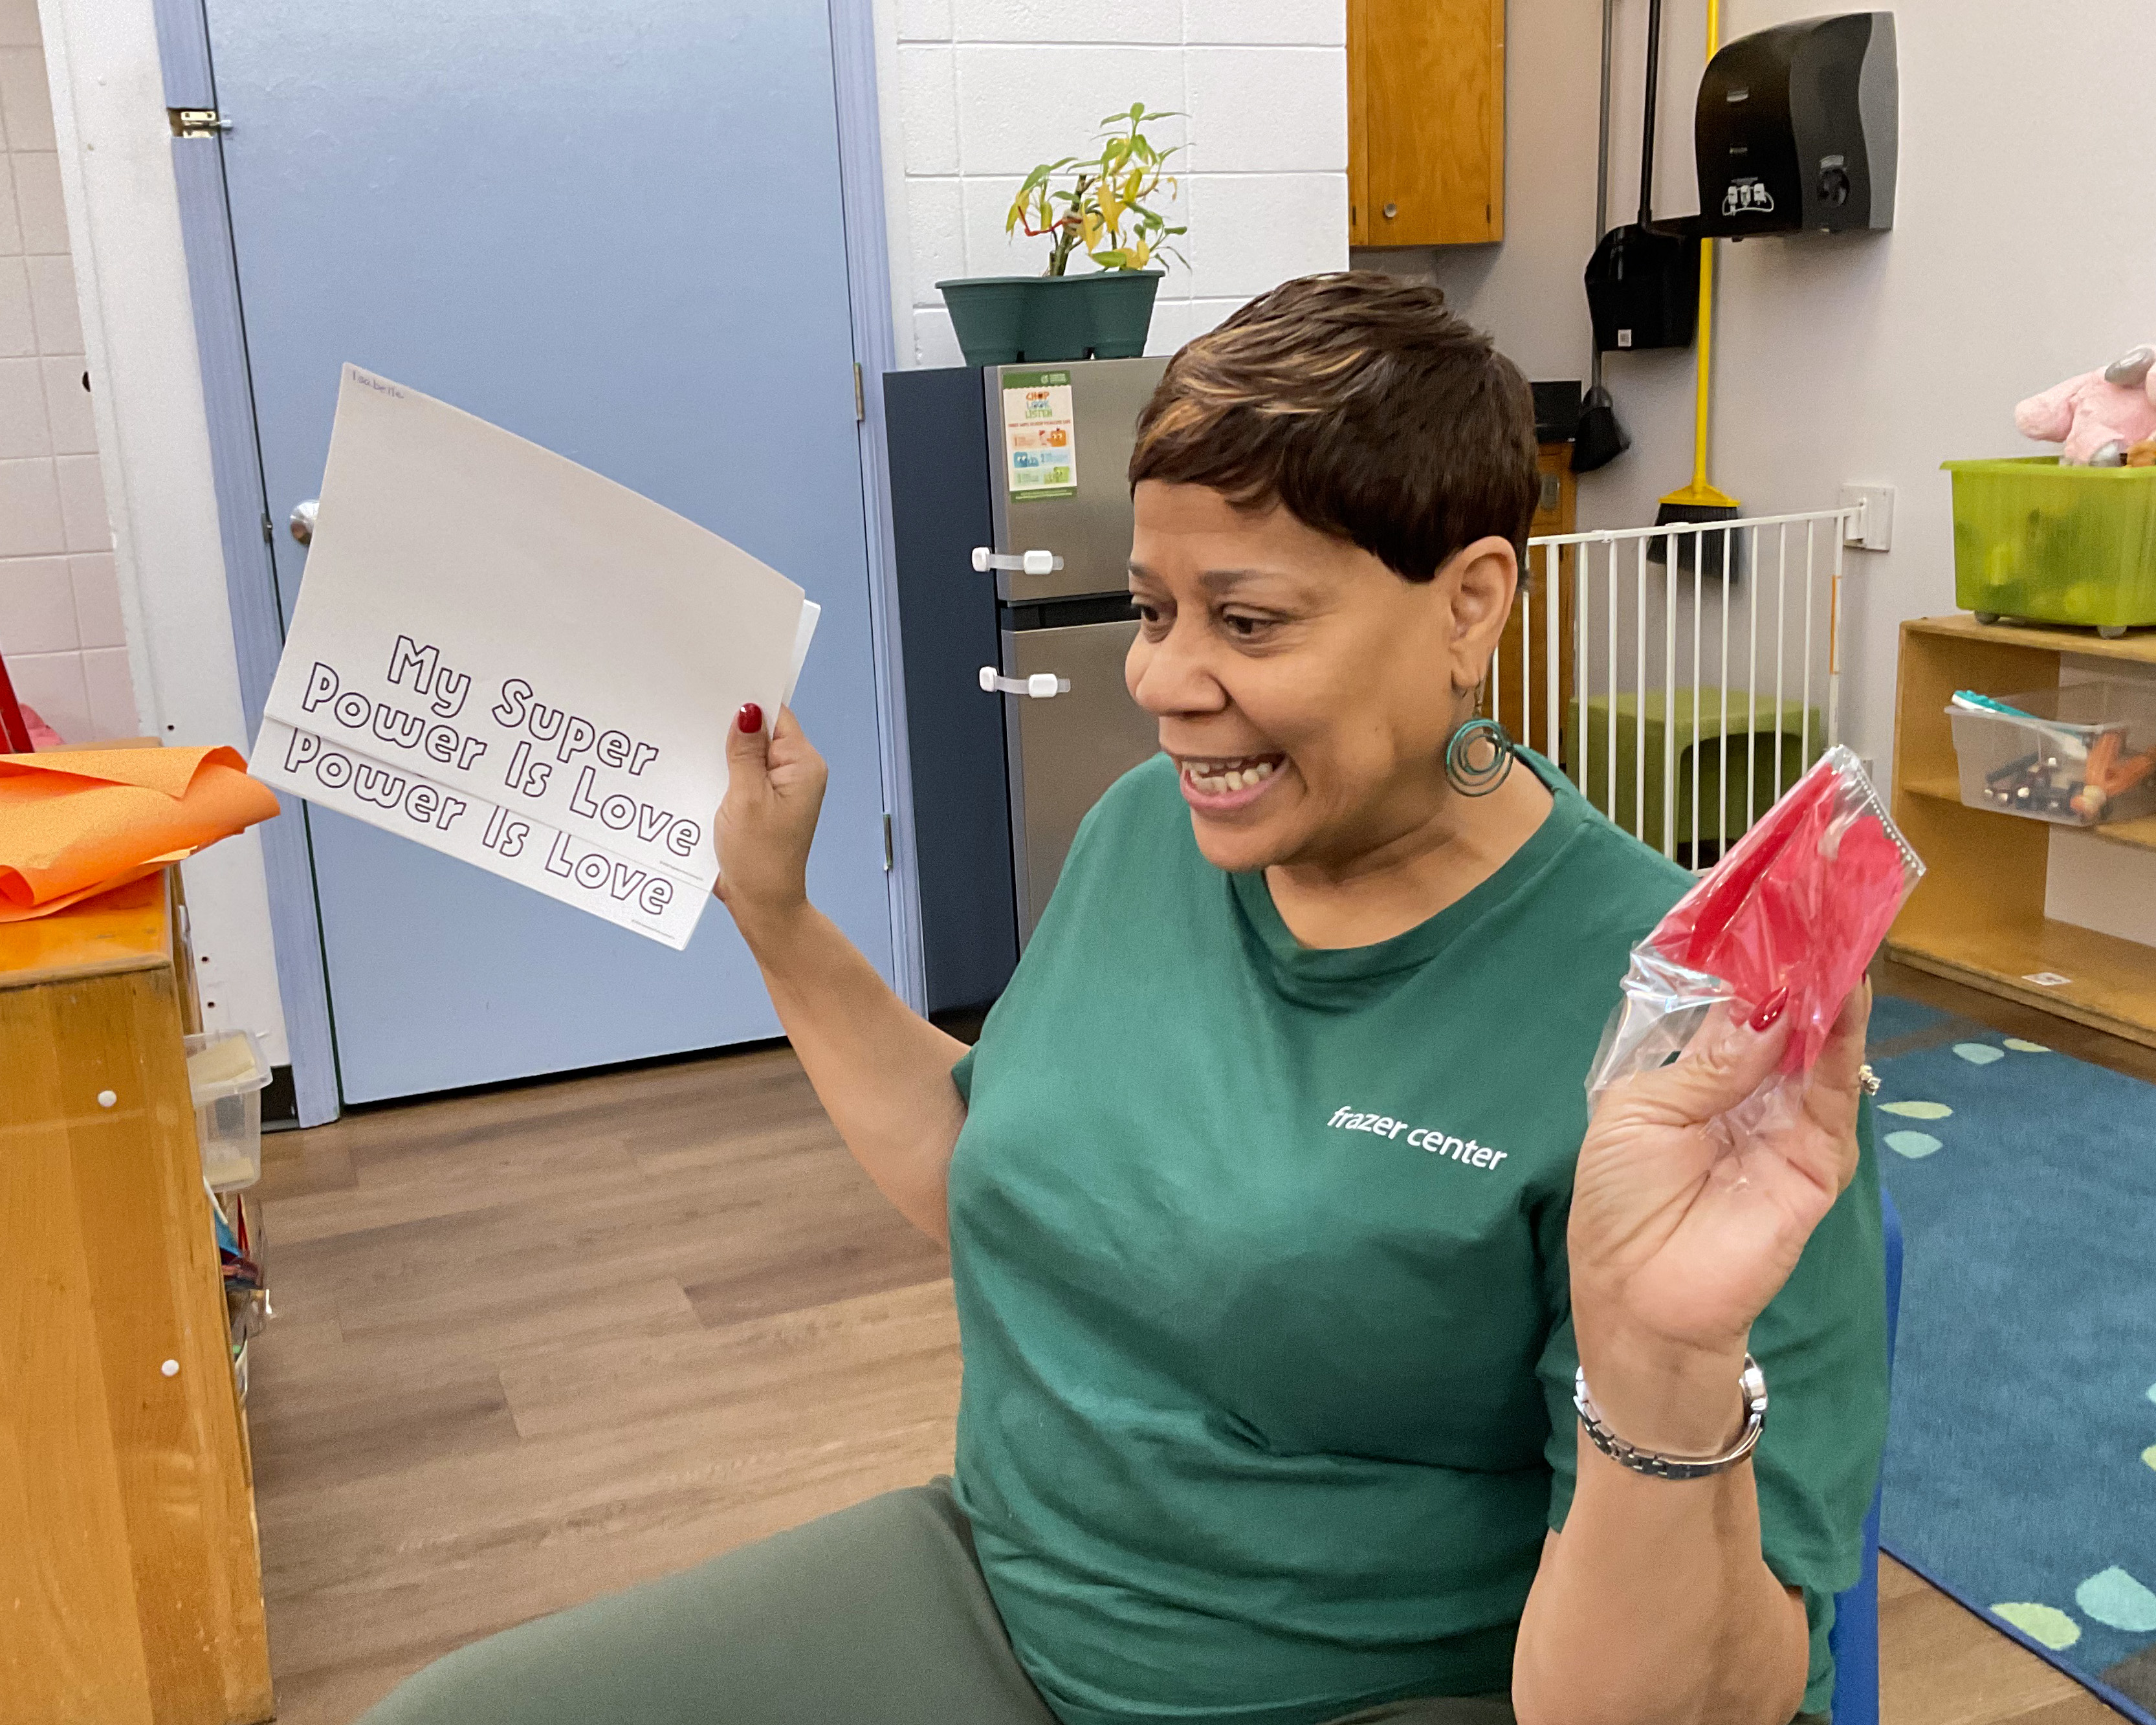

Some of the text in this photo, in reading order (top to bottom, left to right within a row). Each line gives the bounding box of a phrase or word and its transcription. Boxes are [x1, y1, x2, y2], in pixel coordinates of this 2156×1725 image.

[1026, 391, 1050, 401] CHOP
[302, 662, 701, 857] Power Is Love
[388, 635, 659, 776] My Super
[284, 727, 673, 915] Power Is Love
[1327, 1106, 1508, 1170] frazer center
